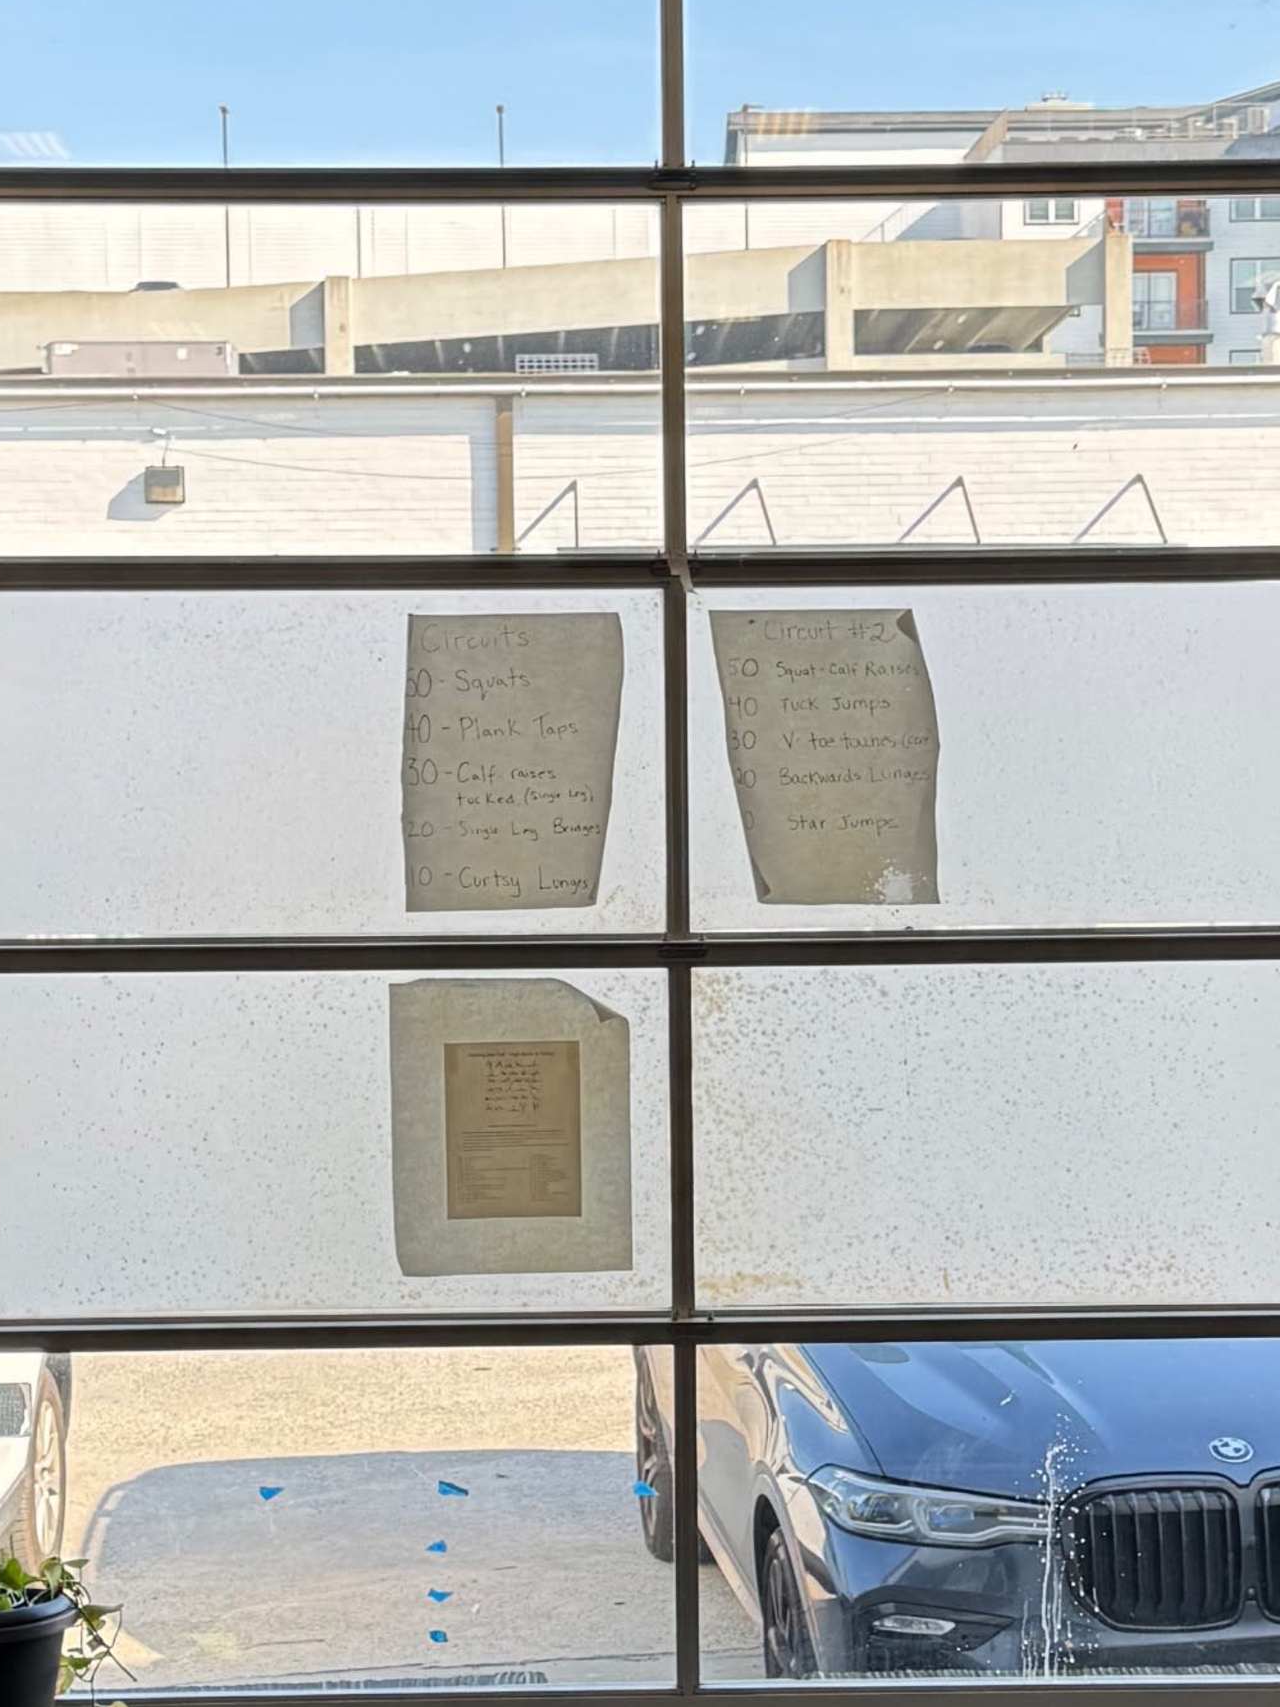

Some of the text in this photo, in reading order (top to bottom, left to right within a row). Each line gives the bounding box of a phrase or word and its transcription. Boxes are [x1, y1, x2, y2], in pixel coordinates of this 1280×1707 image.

[421, 623, 530, 653] Circuits
[764, 620, 839, 641] Circuit
[727, 657, 759, 678] 50
[454, 667, 531, 701] Squats
[727, 696, 758, 719] 40
[832, 697, 891, 717] Jumps
[459, 715, 521, 741] Plank
[532, 712, 579, 741] Taps
[407, 757, 439, 786] 30
[457, 761, 496, 784] Calf
[510, 768, 557, 780] raises
[778, 767, 862, 787] Backwards
[407, 820, 434, 837] 20
[787, 815, 826, 831] Star
[408, 864, 433, 888] 10
[458, 865, 521, 898] Curtsy
[538, 865, 589, 894] Lunges
